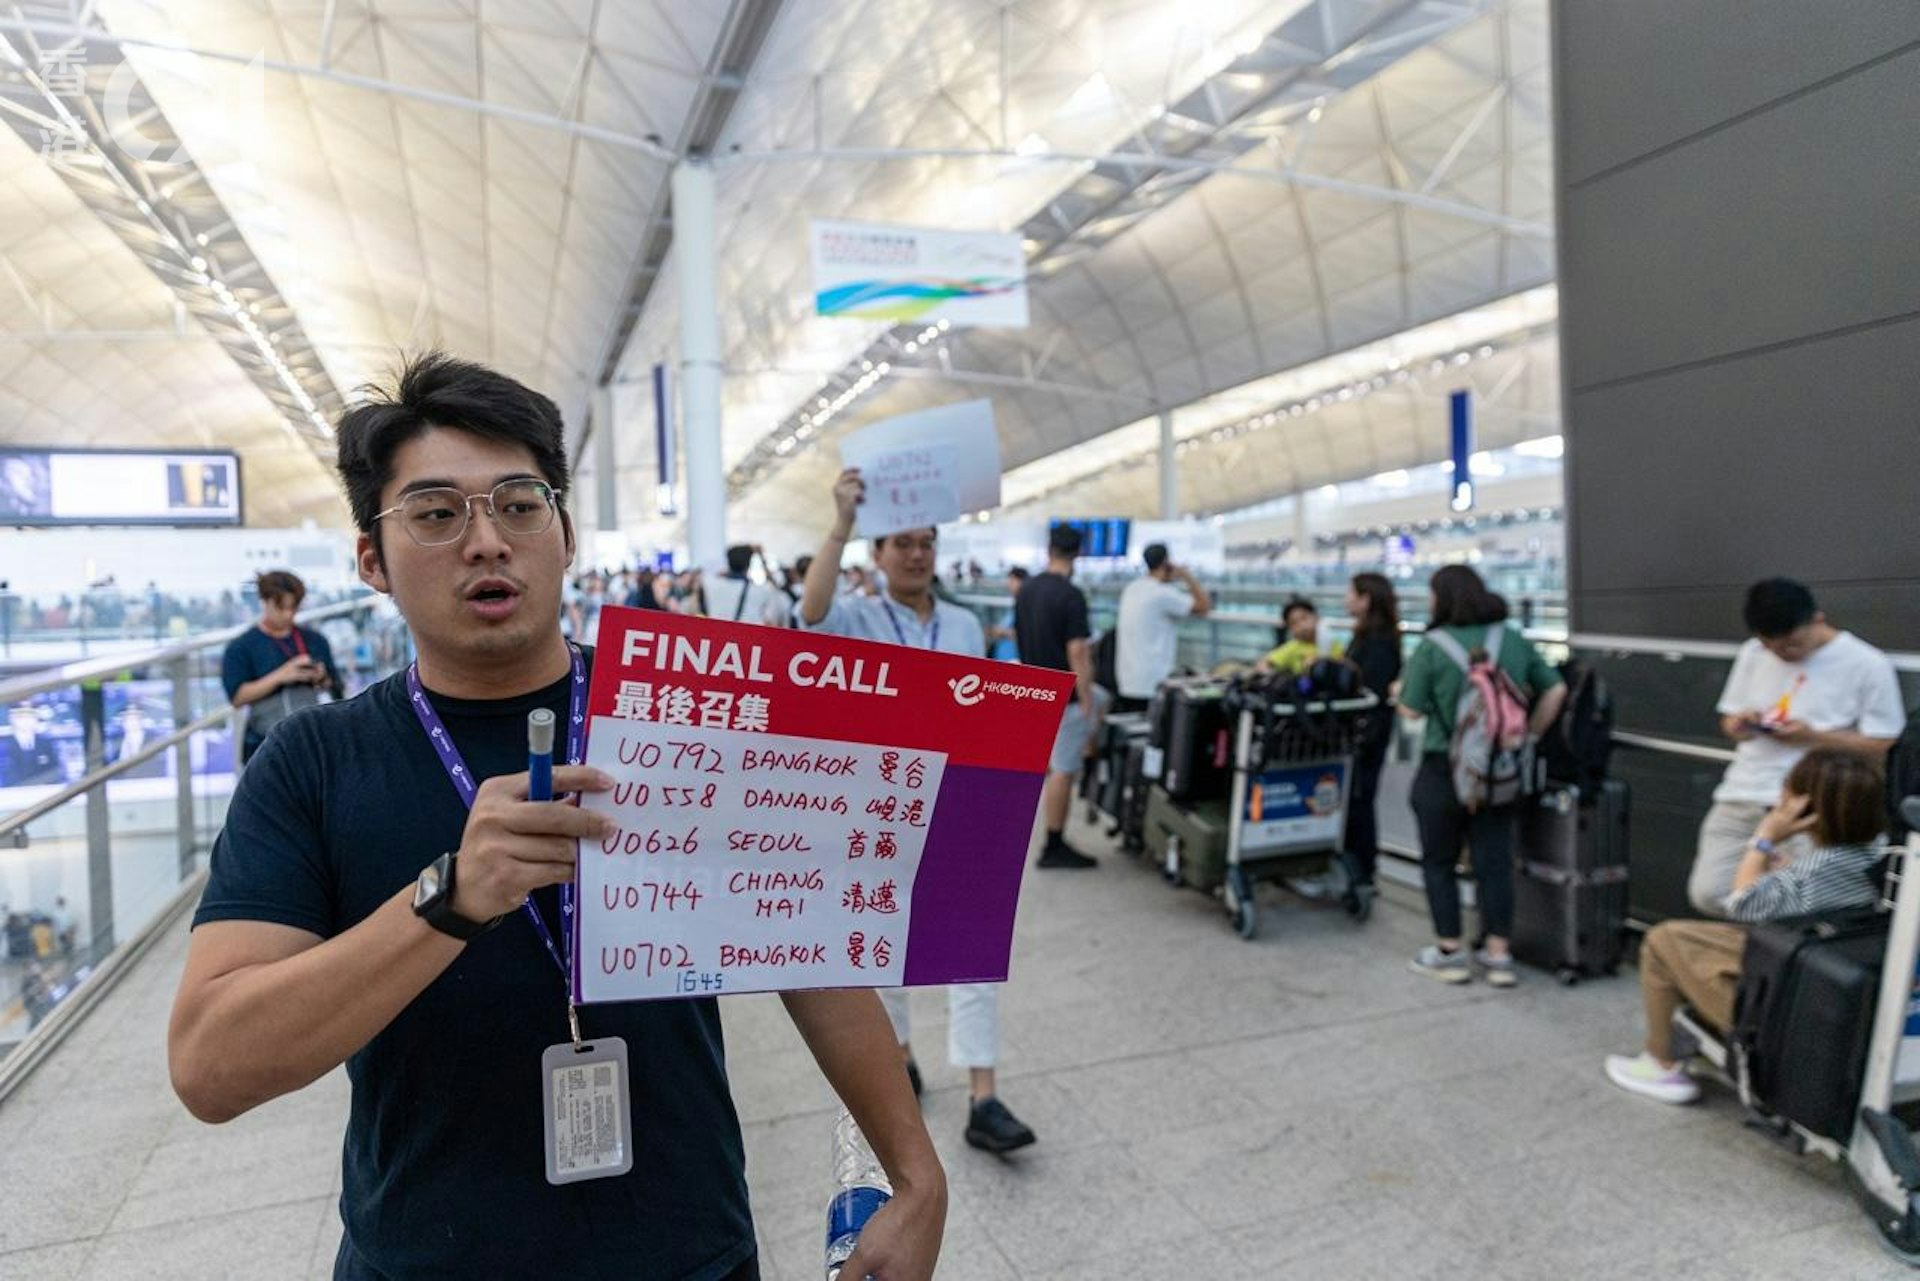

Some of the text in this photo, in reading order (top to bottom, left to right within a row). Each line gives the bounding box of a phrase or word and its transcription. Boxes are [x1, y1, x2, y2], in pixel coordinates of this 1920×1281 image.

[621, 629, 899, 697] FINAL CALL
[612, 680, 770, 732] 最後召集
[742, 749, 858, 776] BANGKOK
[878, 751, 927, 790] 曼谷
[743, 788, 848, 816] DANANG
[728, 830, 812, 853] SEOUL
[846, 829, 898, 860] 首爾
[729, 868, 824, 894] CHIANG
[841, 879, 900, 914] 清邁
[755, 898, 805, 919] MAI
[719, 943, 826, 968] BANGKOK
[847, 932, 893, 970] 曼谷
